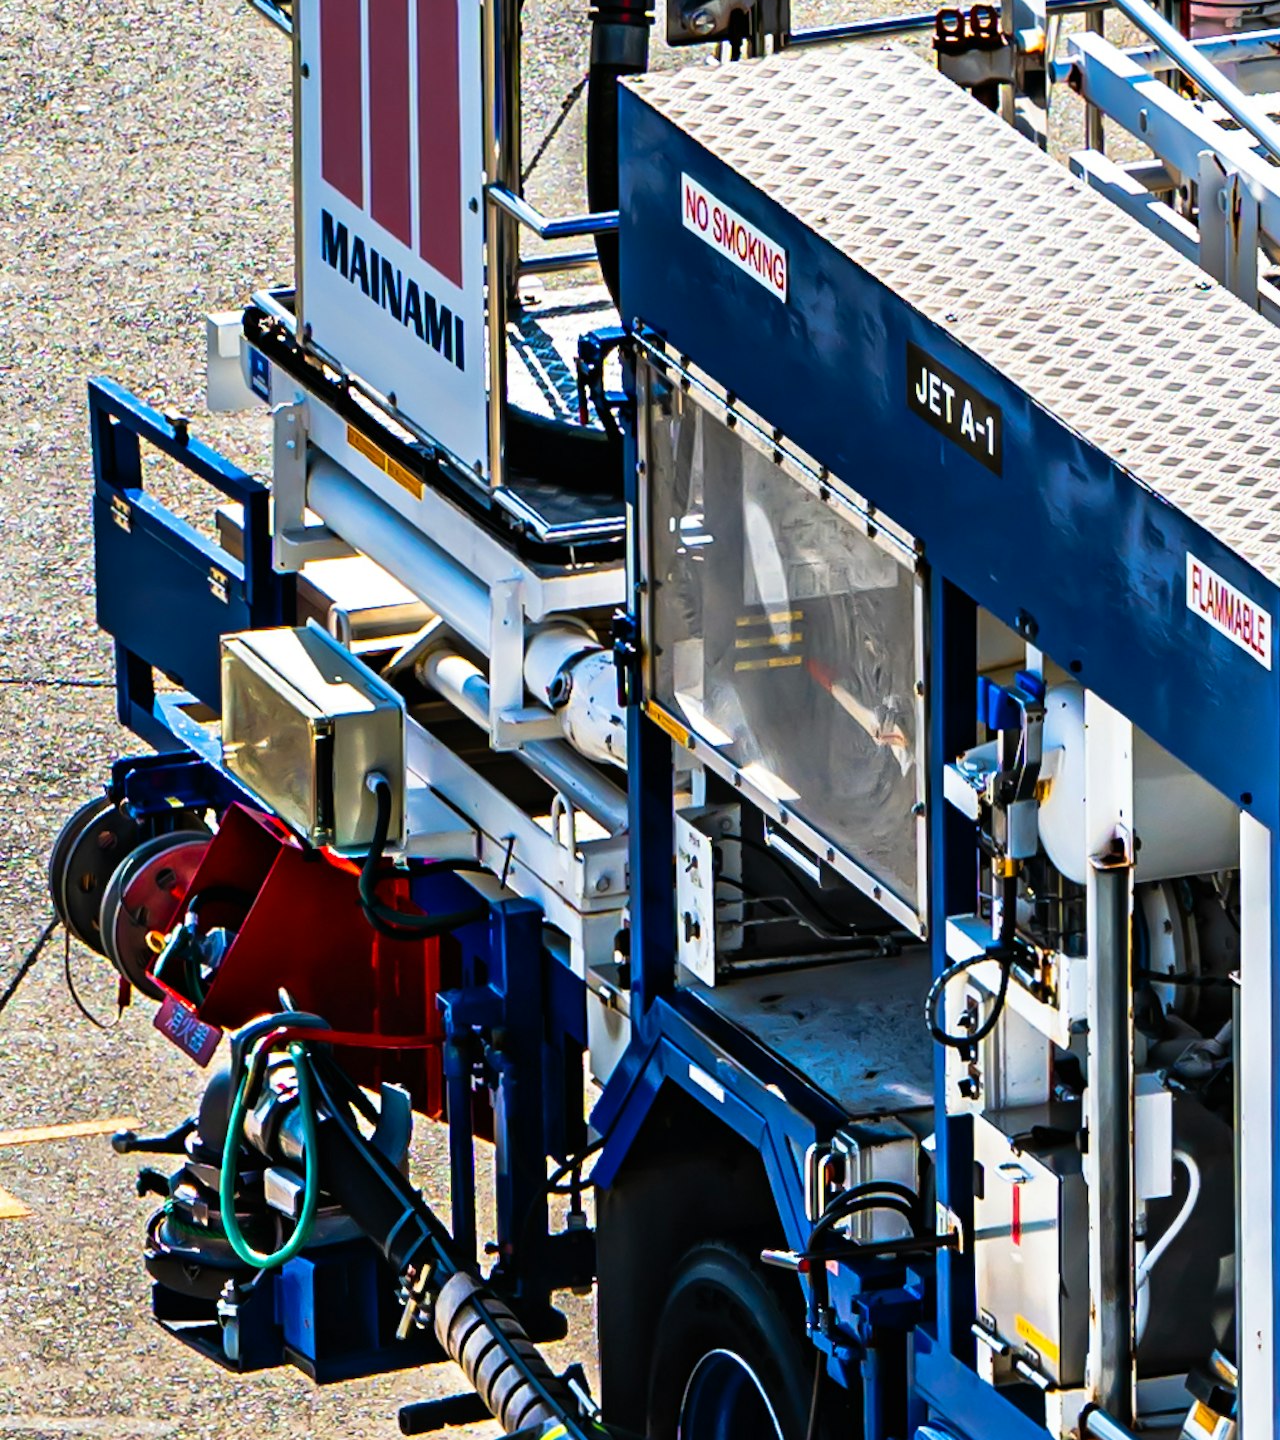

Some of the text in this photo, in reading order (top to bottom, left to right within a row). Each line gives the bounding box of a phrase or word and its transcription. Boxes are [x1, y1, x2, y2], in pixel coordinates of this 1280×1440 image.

[686, 184, 785, 291] NO SMOKING
[321, 208, 465, 373] MAINAMI
[915, 367, 995, 456] JET A-1
[1192, 563, 1265, 657] FLAMMABLE
